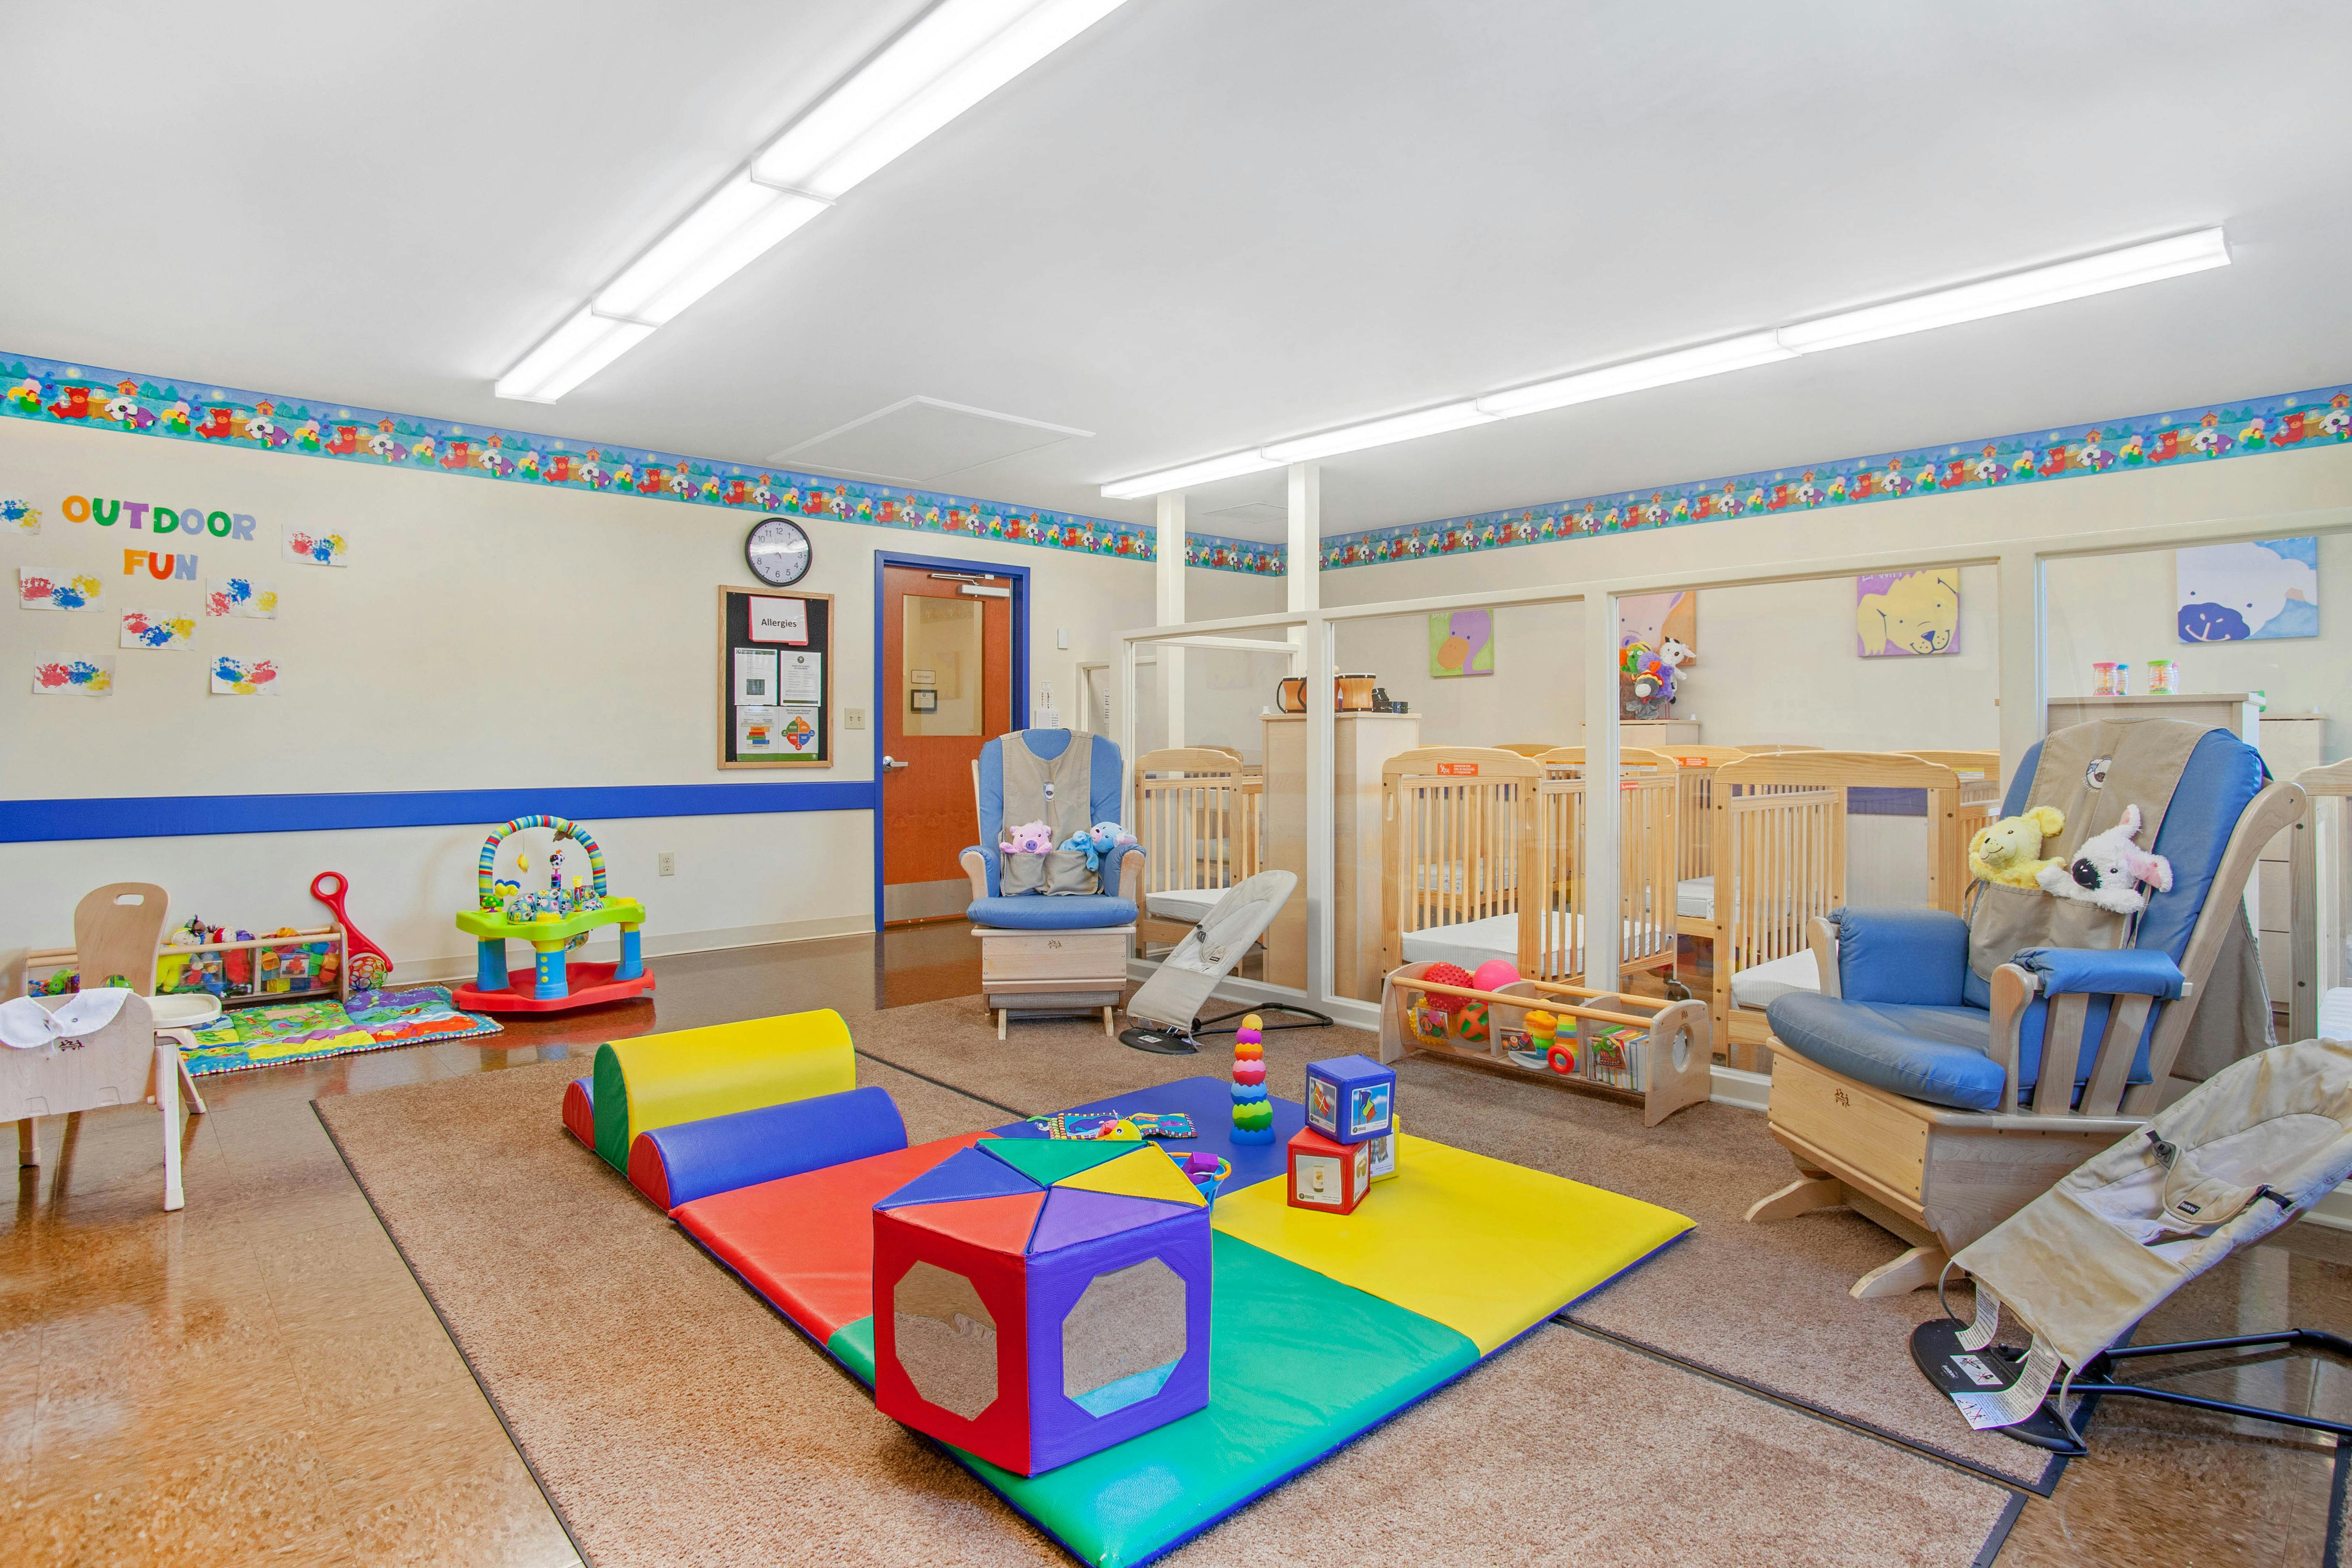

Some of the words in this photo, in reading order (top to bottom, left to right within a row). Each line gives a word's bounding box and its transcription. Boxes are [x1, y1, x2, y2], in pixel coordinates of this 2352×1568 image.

[62, 495, 257, 541] OUTDOOR
[123, 548, 198, 581] FUN
[761, 618, 797, 628] Allergies
